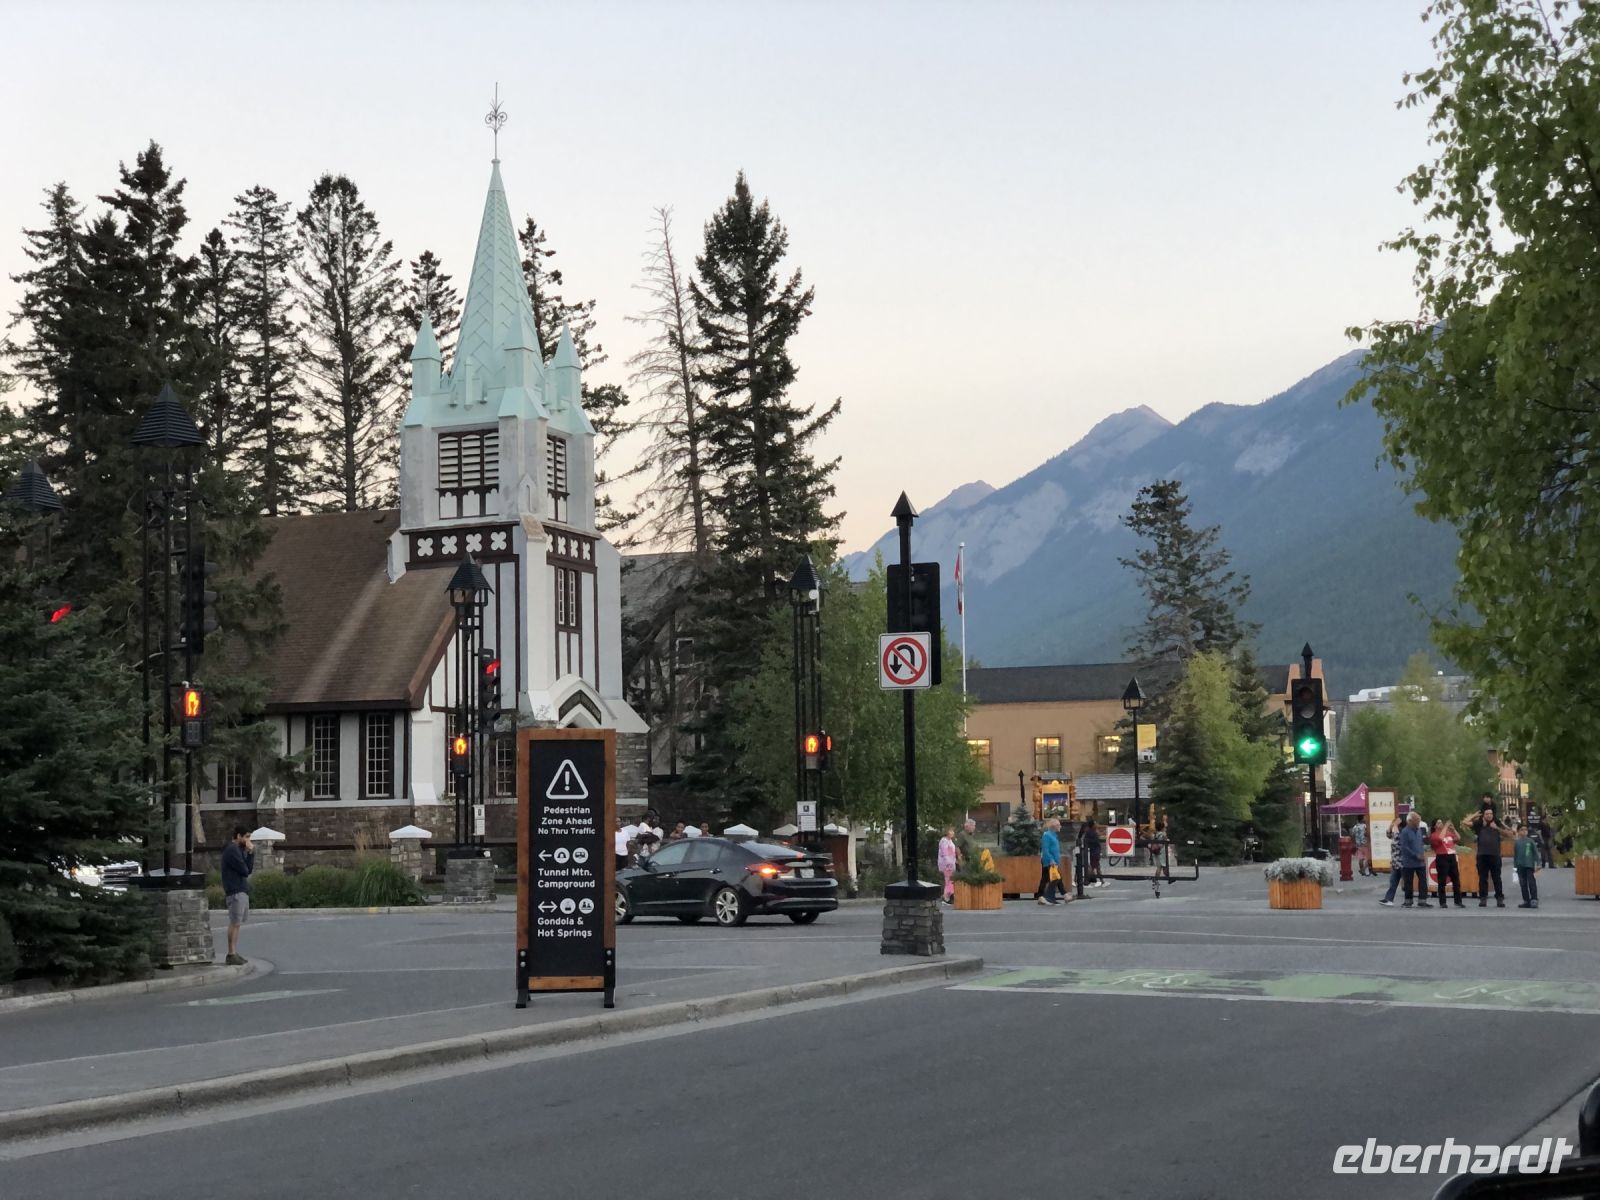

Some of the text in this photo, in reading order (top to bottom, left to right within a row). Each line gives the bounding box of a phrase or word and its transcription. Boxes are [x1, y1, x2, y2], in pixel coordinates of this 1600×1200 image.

[543, 806, 590, 814] Pedestrian
[541, 817, 593, 825] Zone Ahead
[538, 868, 592, 876] Tunnel Mtn.
[537, 880, 596, 889] Campground
[537, 917, 584, 926] Gondola &
[537, 929, 592, 938] Hot Springs
